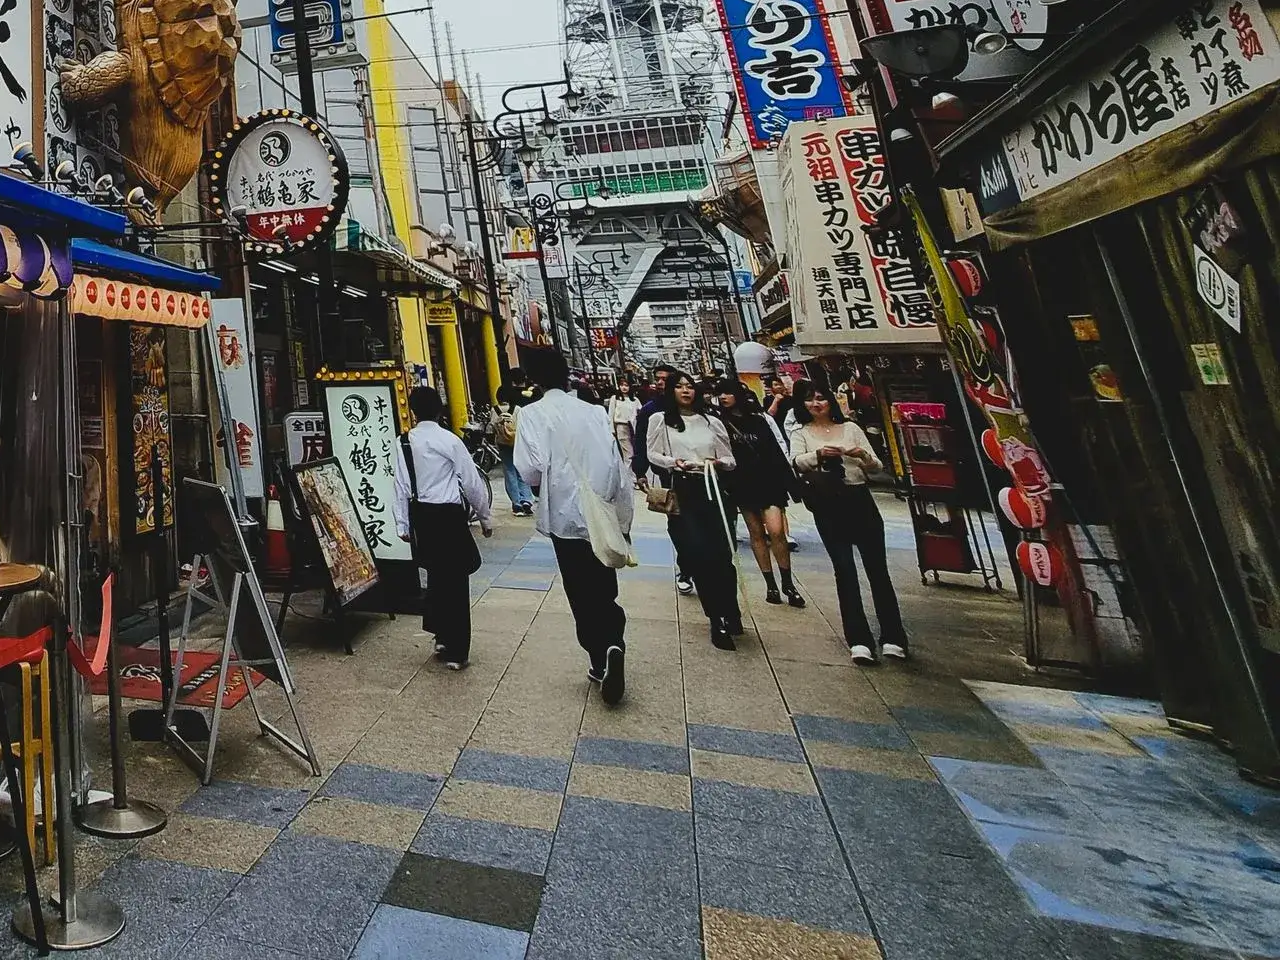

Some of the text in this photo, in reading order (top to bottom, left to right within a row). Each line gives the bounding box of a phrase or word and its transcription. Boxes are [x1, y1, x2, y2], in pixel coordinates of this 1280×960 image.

[905, 1, 1001, 32] かわ
[1031, 44, 1175, 178] かわち屋
[980, 152, 1009, 200] Asahi
[259, 213, 306, 229] 年中無休
[801, 132, 879, 330] 元祖串カツ専門店
[349, 438, 393, 550] 鶴亀家
